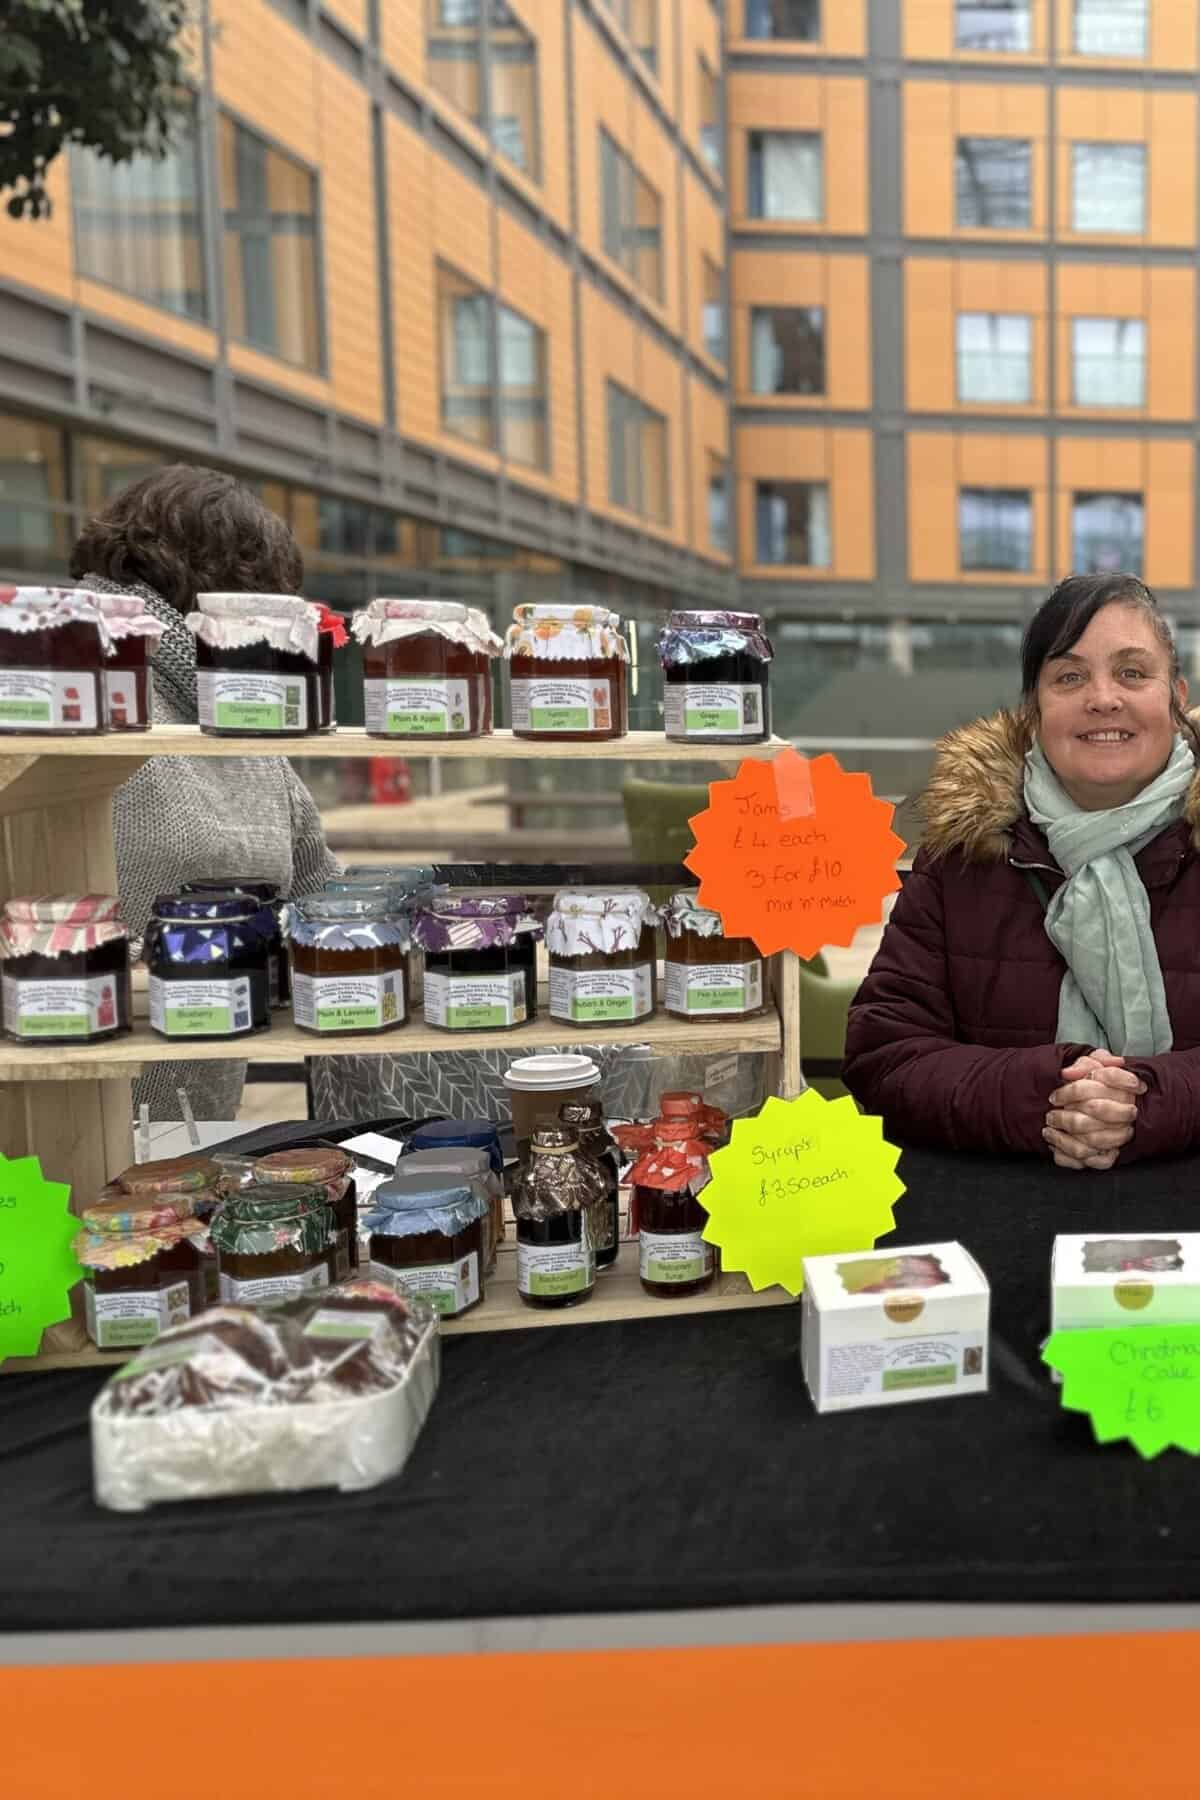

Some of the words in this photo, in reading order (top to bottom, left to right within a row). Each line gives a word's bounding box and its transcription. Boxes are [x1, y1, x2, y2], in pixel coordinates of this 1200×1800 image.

[779, 827, 828, 848] each
[745, 869, 765, 889] 3
[767, 865, 800, 883] for
[808, 856, 843, 883] £10
[344, 1008, 376, 1016] Lavender
[811, 1167, 850, 1189] each
[1123, 1388, 1164, 1422] £6
